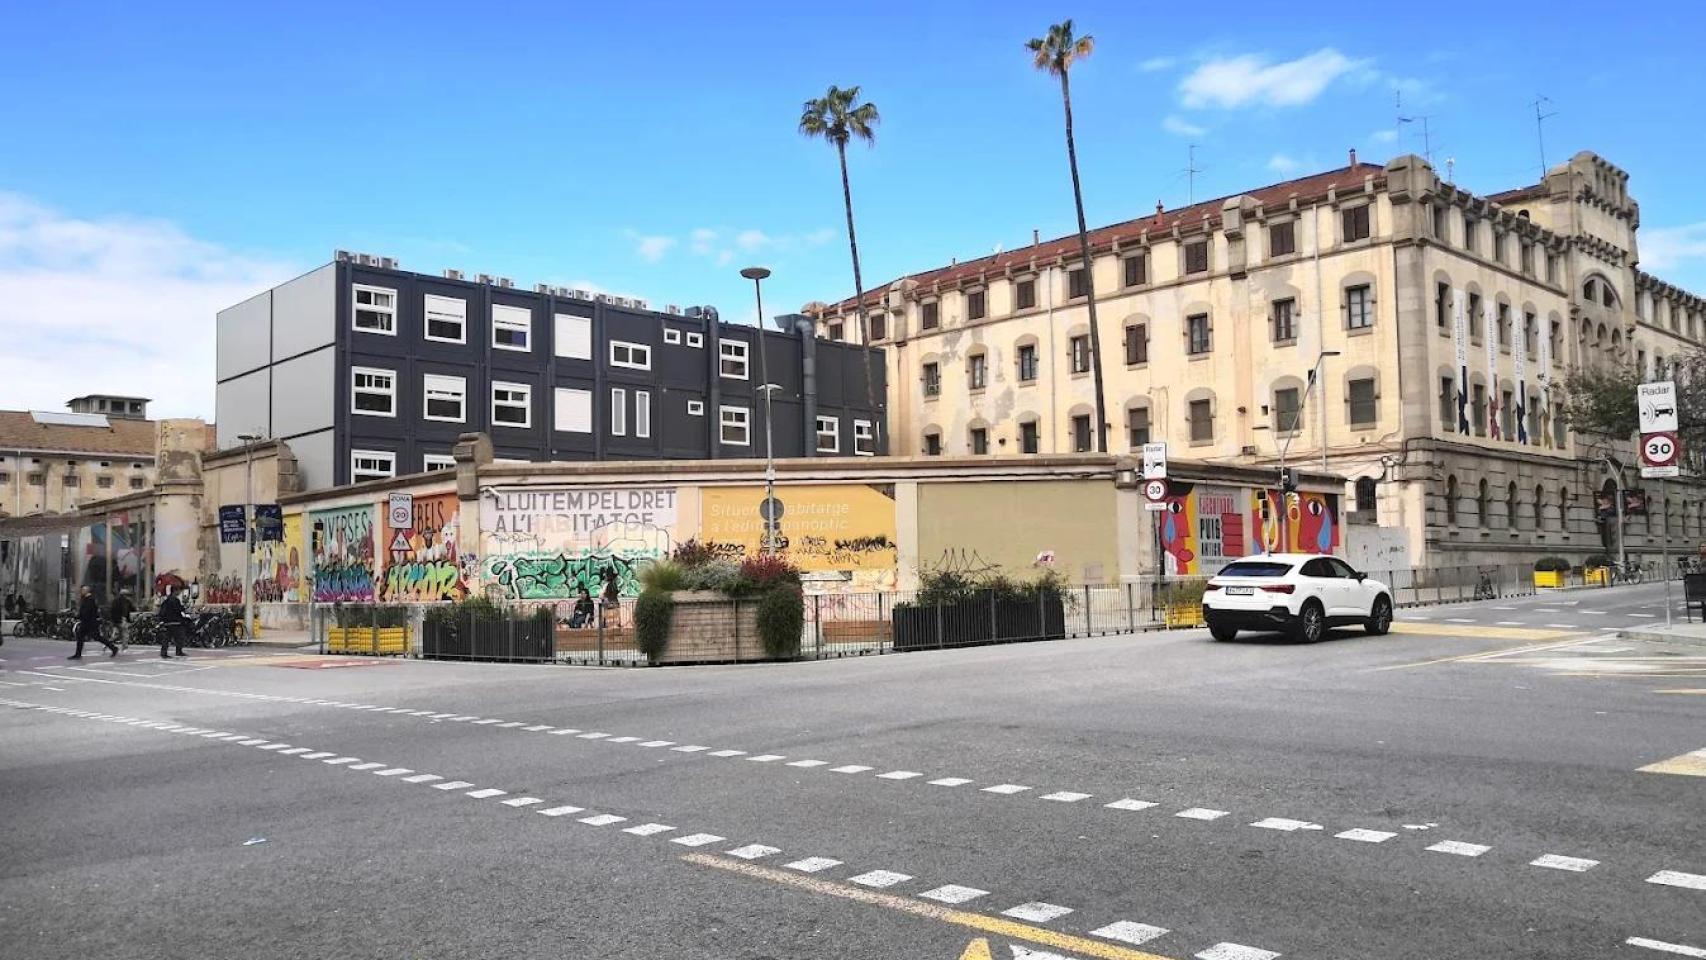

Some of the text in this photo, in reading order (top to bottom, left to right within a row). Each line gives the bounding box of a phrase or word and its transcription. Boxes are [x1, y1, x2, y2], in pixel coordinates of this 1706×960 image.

[1642, 386, 1670, 396] Radar
[1649, 444, 1671, 455] 30
[1150, 486, 1161, 495] 30
[495, 490, 676, 511] LLUITEM PEL DRET
[395, 510, 407, 519] 20
[318, 511, 368, 542] IVERSES
[495, 514, 507, 533] A
